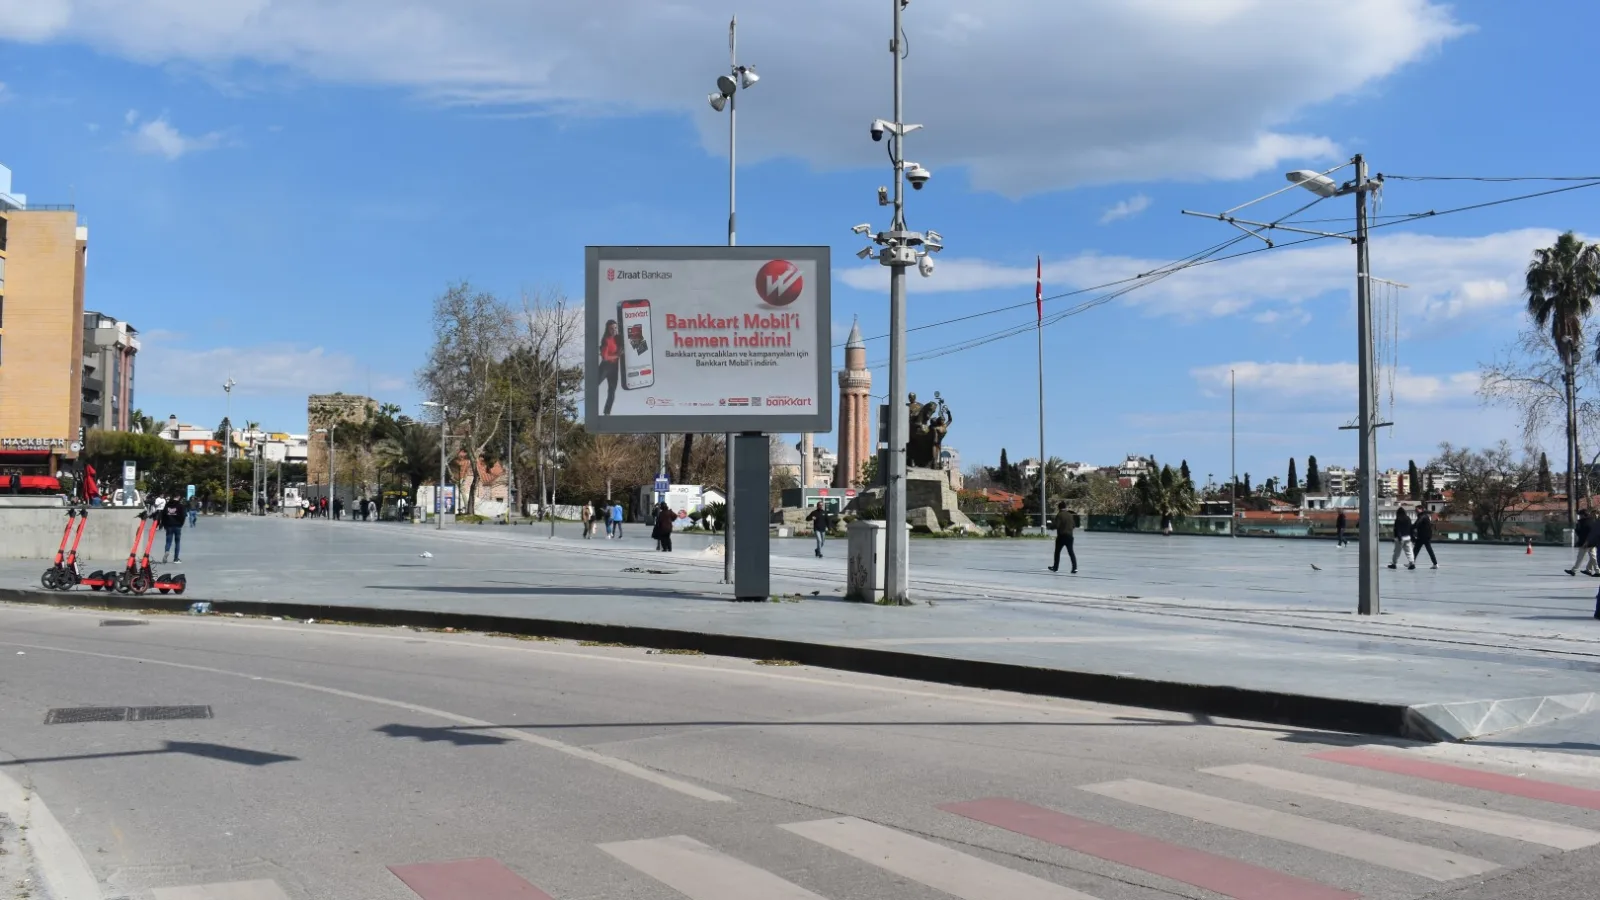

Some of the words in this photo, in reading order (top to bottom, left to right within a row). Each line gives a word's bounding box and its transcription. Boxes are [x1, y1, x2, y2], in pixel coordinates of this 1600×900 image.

[617, 270, 640, 279] Ziraat
[641, 270, 673, 279] Bankası
[665, 313, 740, 330] Bankkart
[743, 313, 800, 330] Mobil'i
[673, 332, 729, 347] hemen
[733, 332, 791, 347] indirin!
[665, 350, 697, 358] Bankkart
[796, 350, 809, 359] için
[695, 359, 728, 367] Bankkart
[766, 397, 812, 407] bankkart
